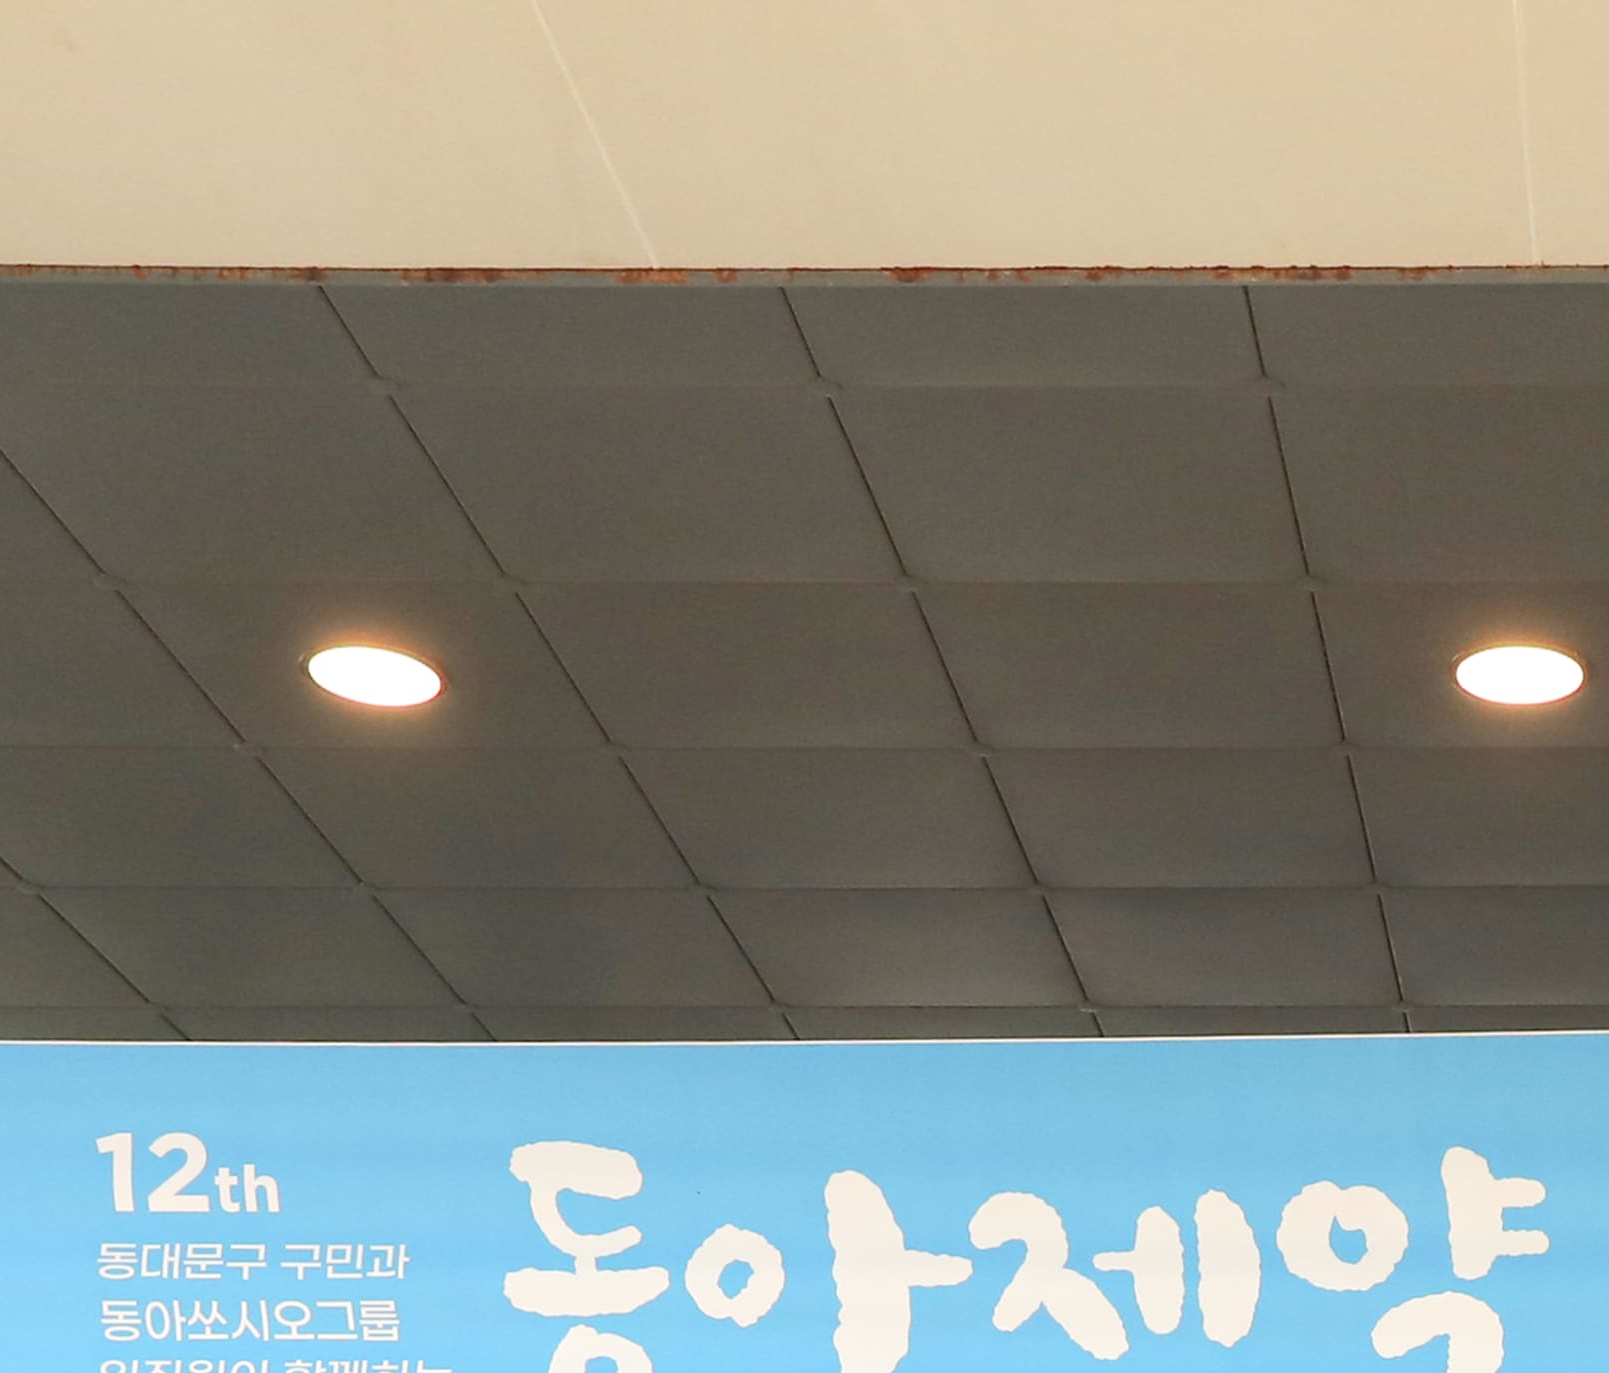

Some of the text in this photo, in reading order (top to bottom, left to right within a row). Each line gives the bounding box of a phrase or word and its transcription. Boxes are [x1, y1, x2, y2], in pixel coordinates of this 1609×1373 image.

[96, 1133, 280, 1213] 12th
[98, 1243, 410, 1280] 동대문구 구민과
[101, 1300, 400, 1341] 동아쏘시오그룹
